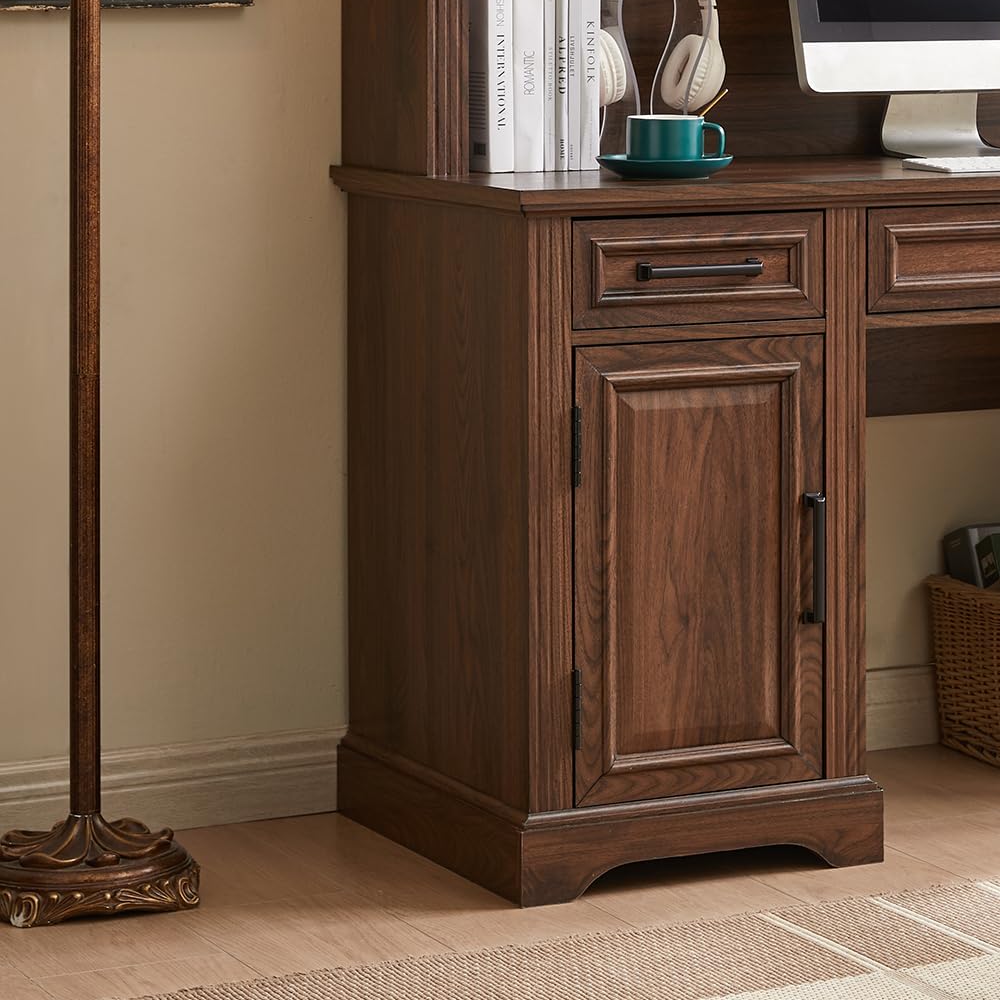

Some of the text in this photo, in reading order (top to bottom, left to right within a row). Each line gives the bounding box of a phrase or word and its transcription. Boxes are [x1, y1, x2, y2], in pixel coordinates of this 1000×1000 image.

[496, 34, 506, 131] INTERNATIONAL
[524, 50, 535, 95] ROMANTIC
[586, 21, 595, 84] KINFOLK
